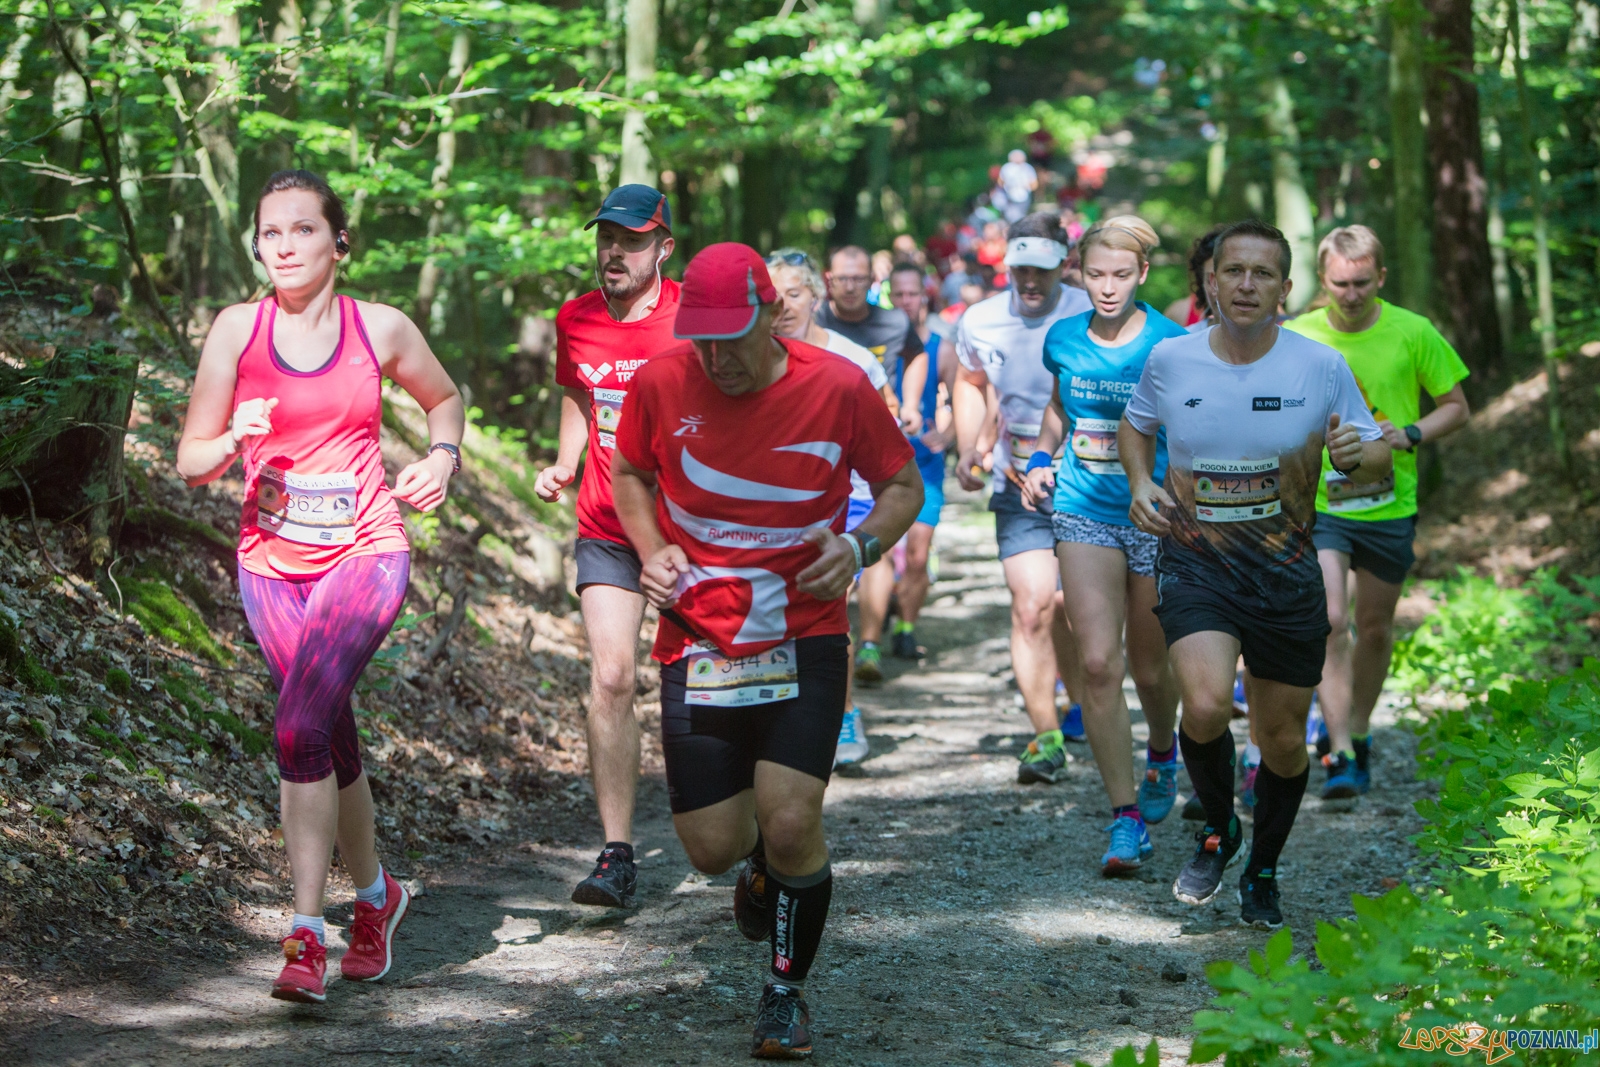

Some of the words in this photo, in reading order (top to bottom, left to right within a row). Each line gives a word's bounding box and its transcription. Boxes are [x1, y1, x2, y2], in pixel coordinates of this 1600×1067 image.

[615, 359, 649, 371] FABR
[616, 371, 635, 382] TR
[602, 392, 624, 402] POGO
[1070, 389, 1084, 398] The
[1086, 390, 1110, 401] Brave
[1112, 394, 1132, 404] Tea
[1184, 398, 1203, 408] 4F
[1240, 462, 1274, 472] WILKIEM
[1218, 478, 1252, 494] 421
[286, 491, 324, 513] 362
[708, 528, 768, 543] RUNNING
[721, 654, 762, 674] 344
